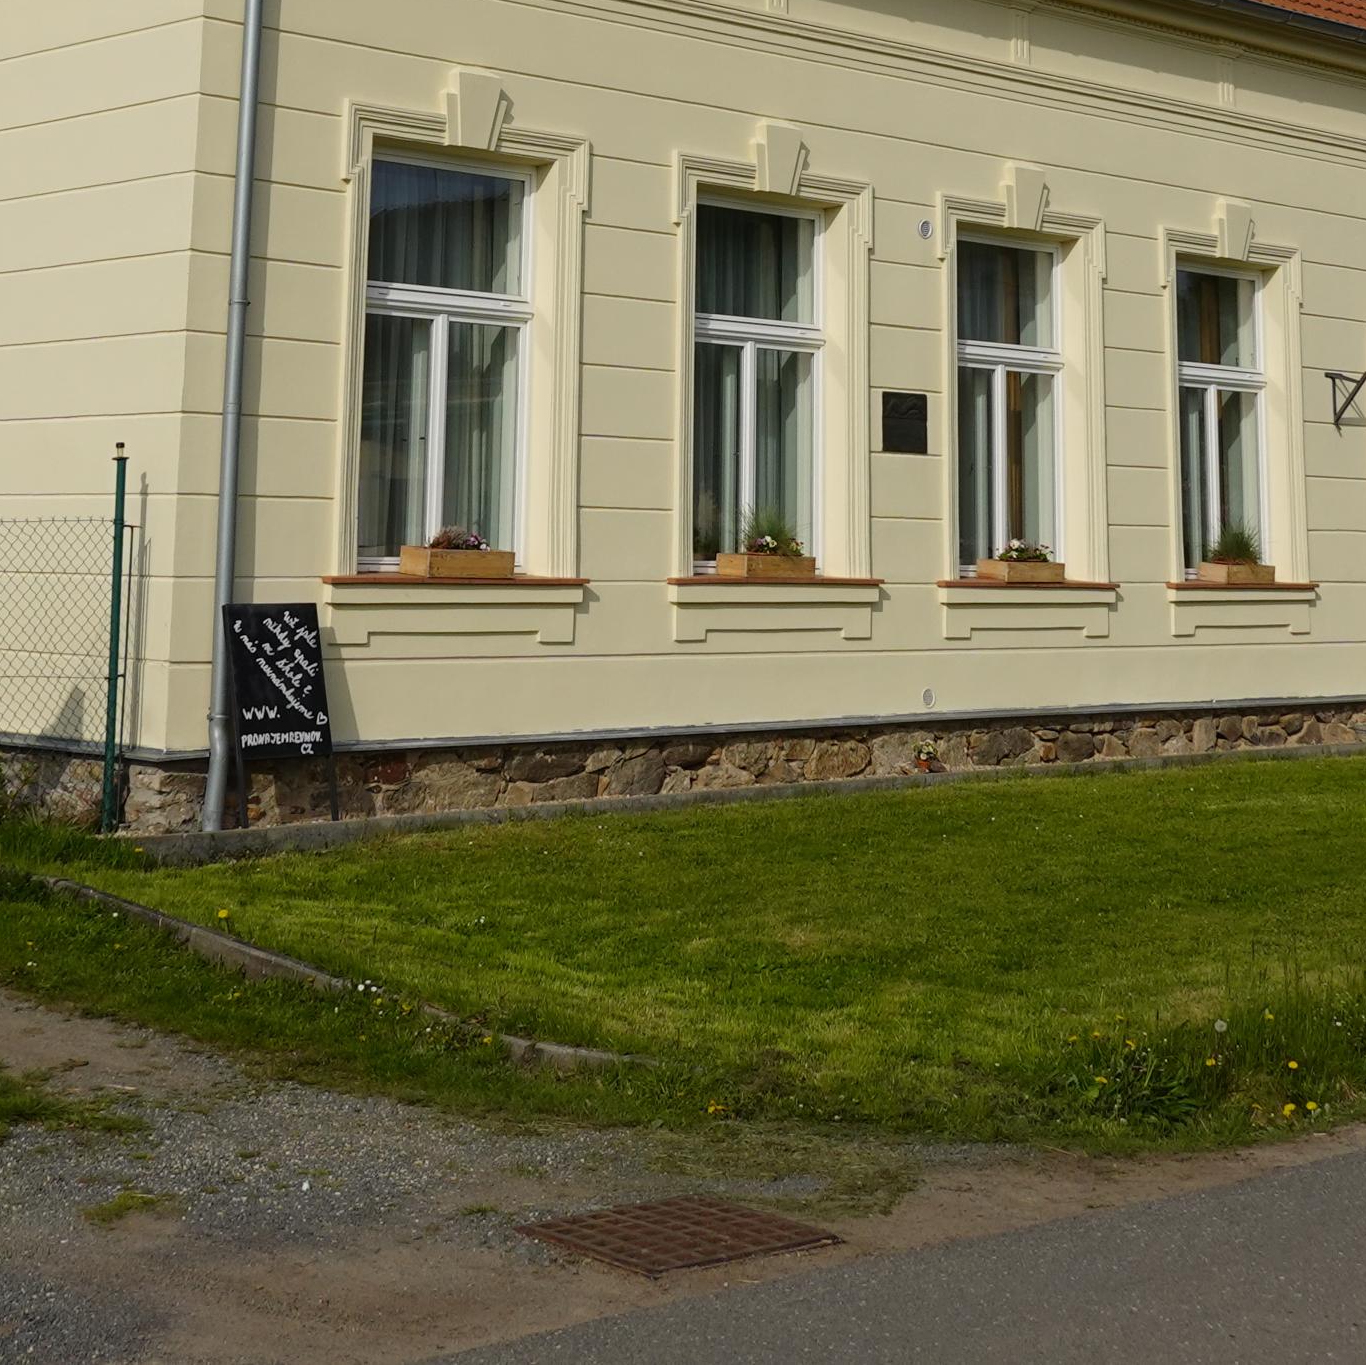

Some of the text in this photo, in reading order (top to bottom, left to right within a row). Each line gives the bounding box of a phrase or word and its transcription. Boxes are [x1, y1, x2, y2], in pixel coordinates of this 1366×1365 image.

[240, 635, 259, 653] nás
[294, 649, 319, 677] spali
[301, 743, 314, 754] CZ
